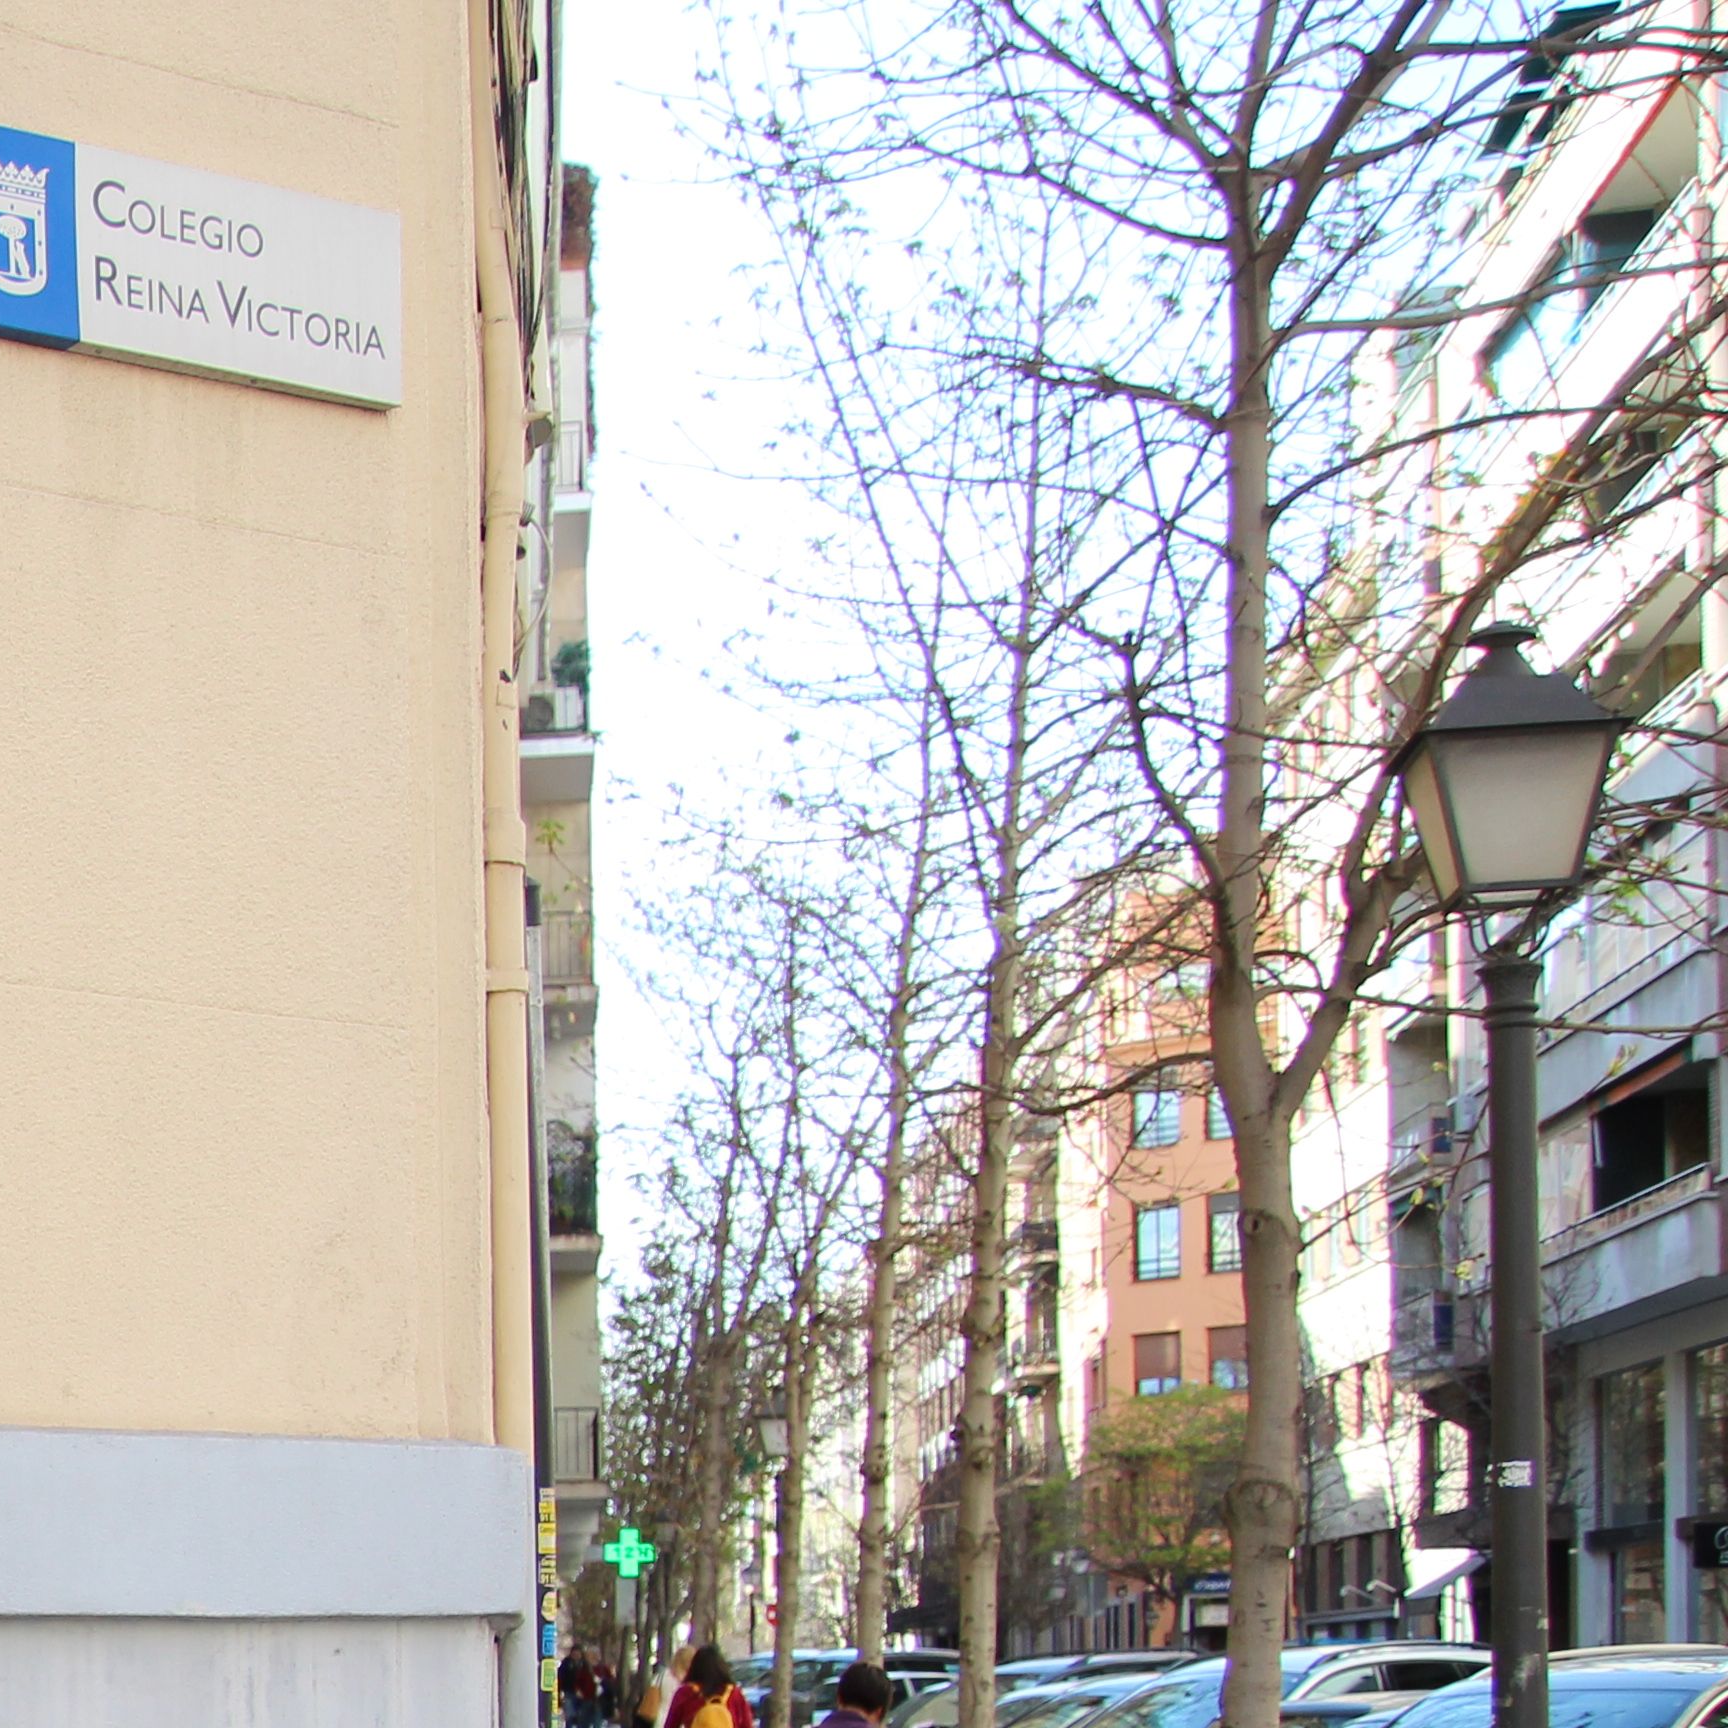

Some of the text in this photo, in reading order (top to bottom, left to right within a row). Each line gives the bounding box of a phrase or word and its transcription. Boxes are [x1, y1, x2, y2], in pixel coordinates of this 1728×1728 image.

[92, 180, 264, 258] COLEGIO
[94, 255, 386, 360] REINA VICTORIA
